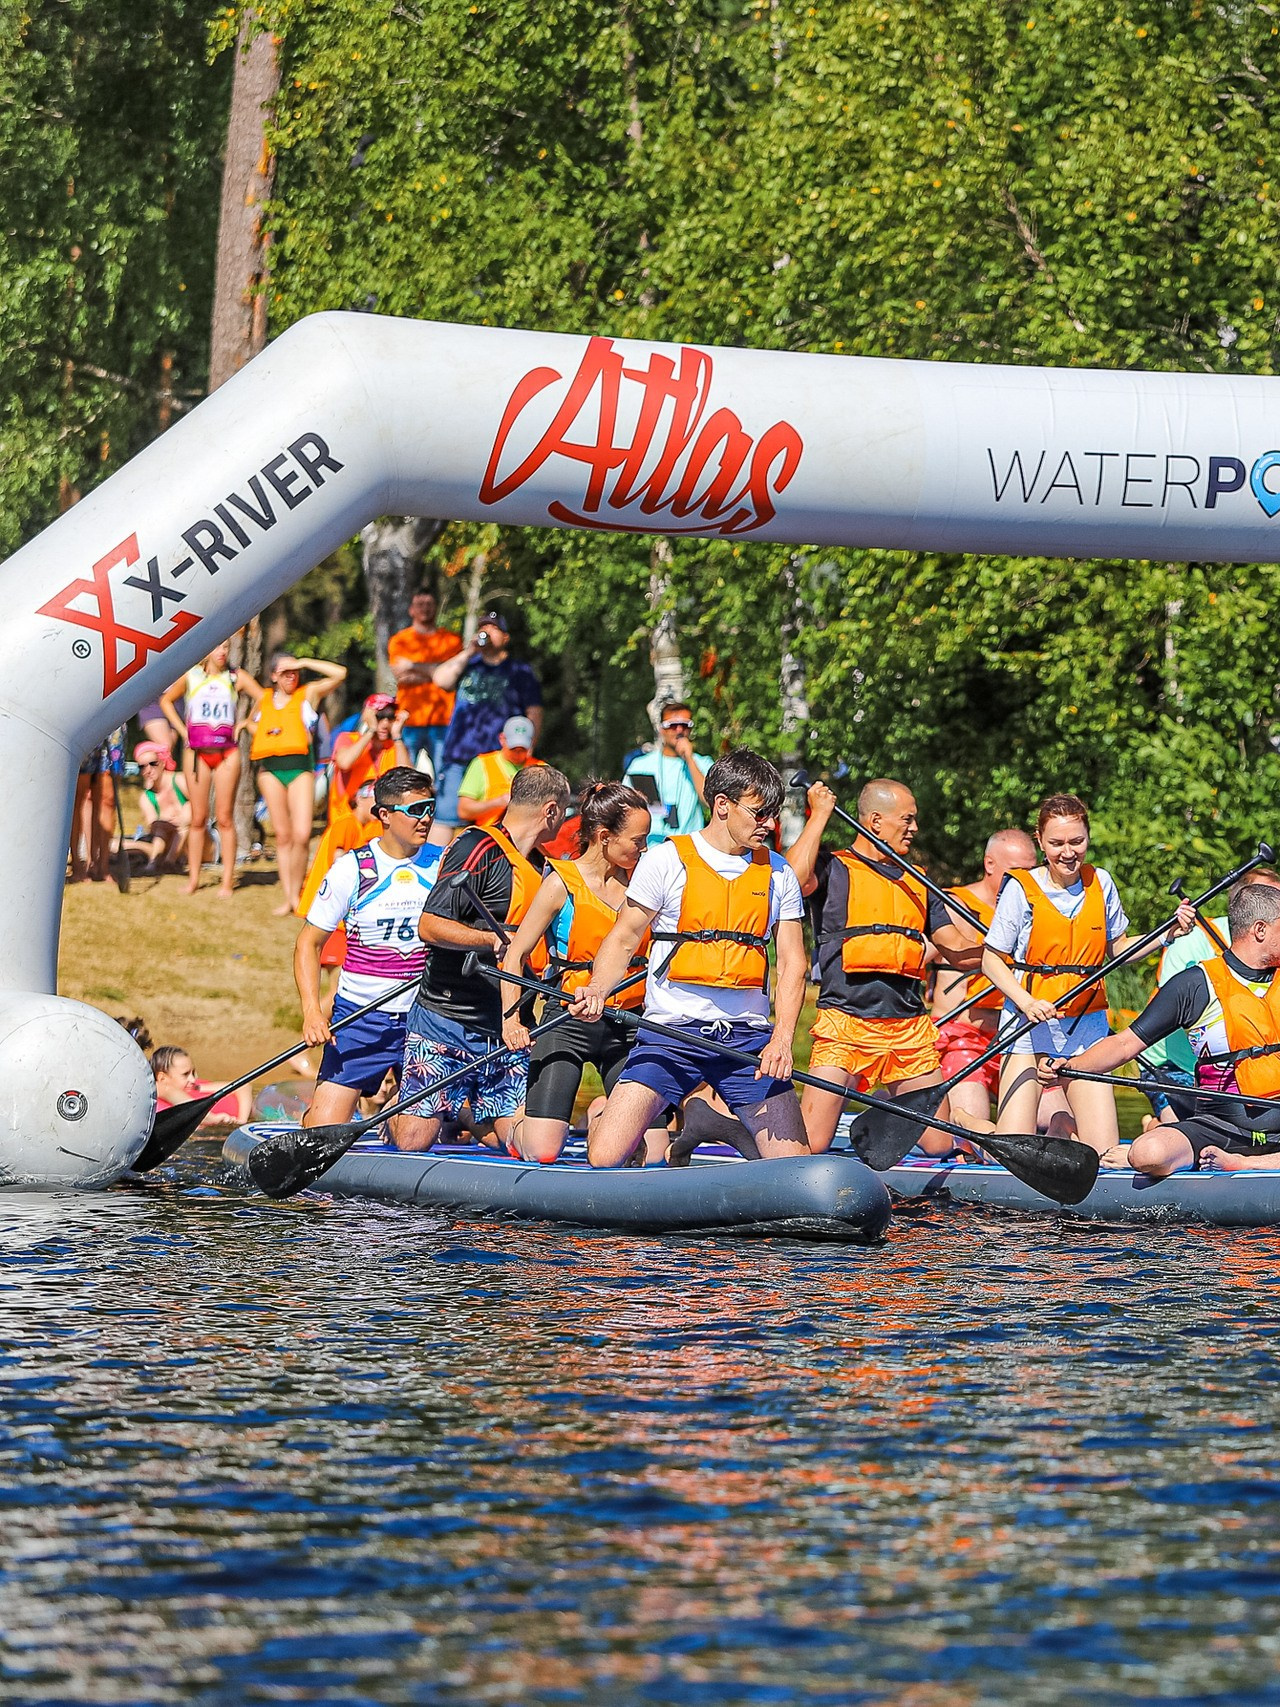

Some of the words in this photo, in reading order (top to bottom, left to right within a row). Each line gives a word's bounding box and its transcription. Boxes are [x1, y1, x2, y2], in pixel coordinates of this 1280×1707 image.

[479, 335, 803, 534] Atlas
[123, 432, 345, 623] X-RIVER
[202, 702, 228, 719] 861
[376, 917, 415, 941] 76
